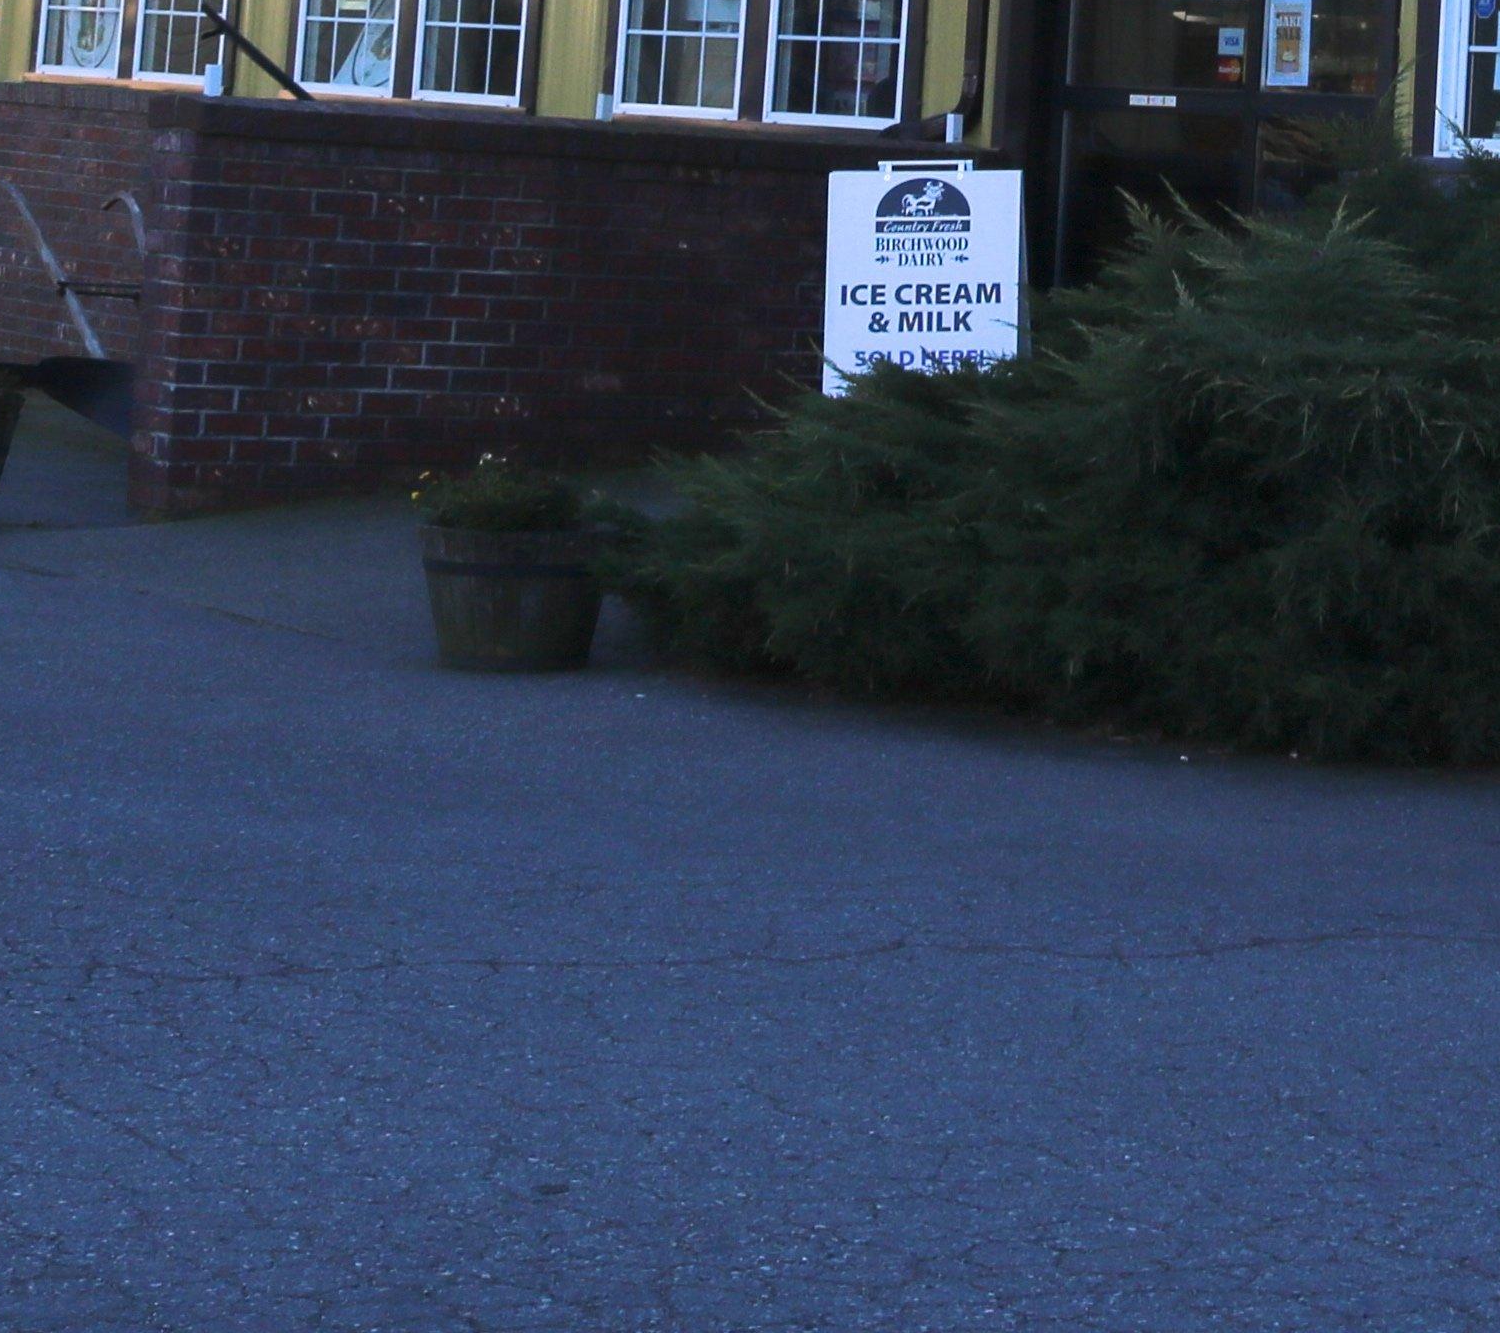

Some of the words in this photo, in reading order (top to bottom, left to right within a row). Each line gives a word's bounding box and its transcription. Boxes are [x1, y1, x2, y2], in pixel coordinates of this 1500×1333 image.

[883, 220, 929, 233] Country
[932, 220, 963, 233] Fresh
[875, 237, 969, 252] BIRCHWOOD
[897, 253, 946, 267] DAIRY
[840, 284, 886, 306] ICE
[894, 283, 1002, 306] CREAM
[868, 311, 890, 333] &
[898, 310, 973, 333] MILK
